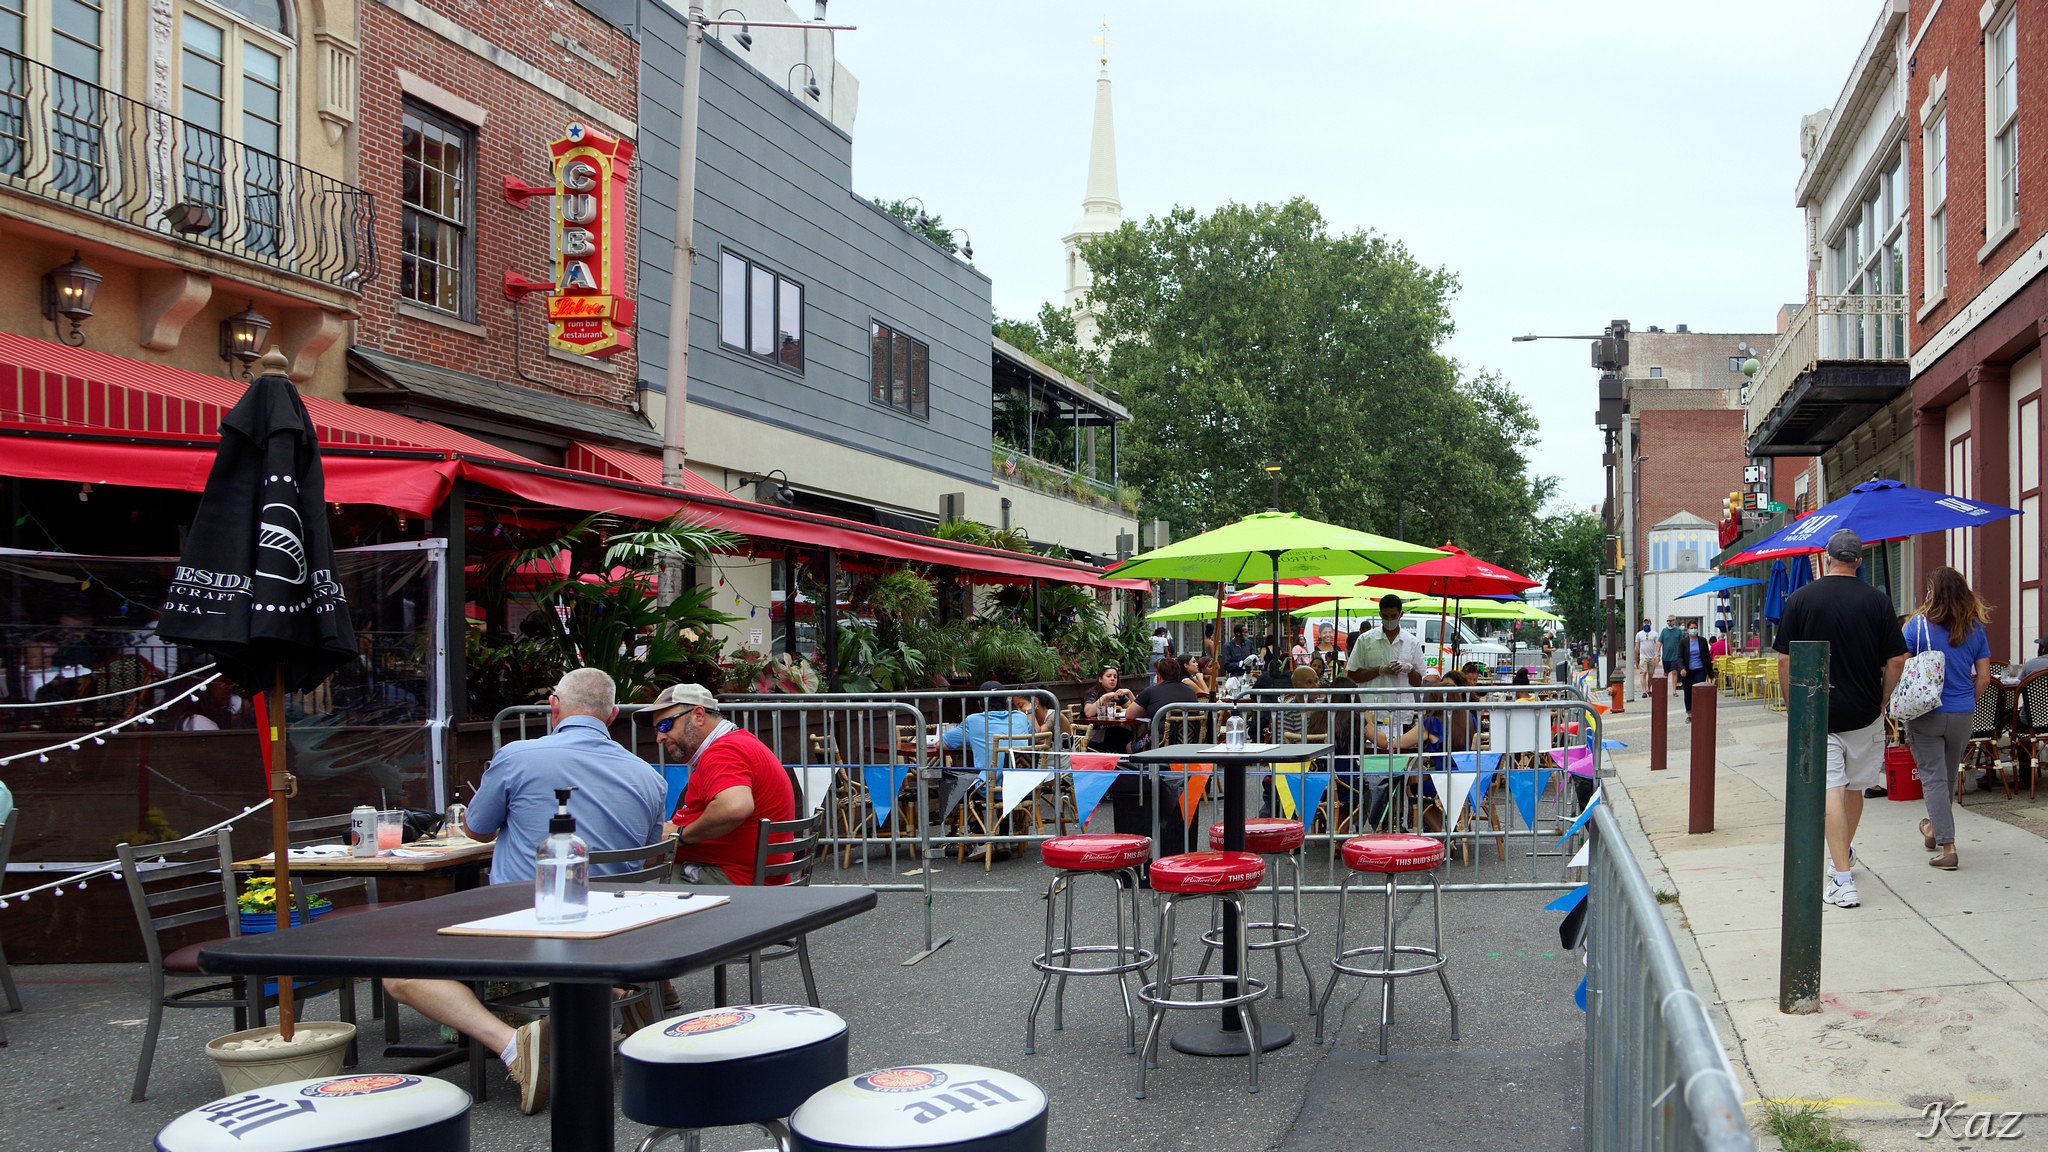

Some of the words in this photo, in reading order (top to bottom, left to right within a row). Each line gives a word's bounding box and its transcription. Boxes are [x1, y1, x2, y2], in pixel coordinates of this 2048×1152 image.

[561, 160, 598, 290] CUBA
[563, 331, 603, 339] restaurant
[1790, 515, 1839, 535] FIJI
[1782, 533, 1813, 542] WATER
[1123, 851, 1137, 860] THIS
[1395, 857, 1412, 866] THIS
[1413, 855, 1430, 865] BUD'S
[1227, 873, 1245, 882] THIS
